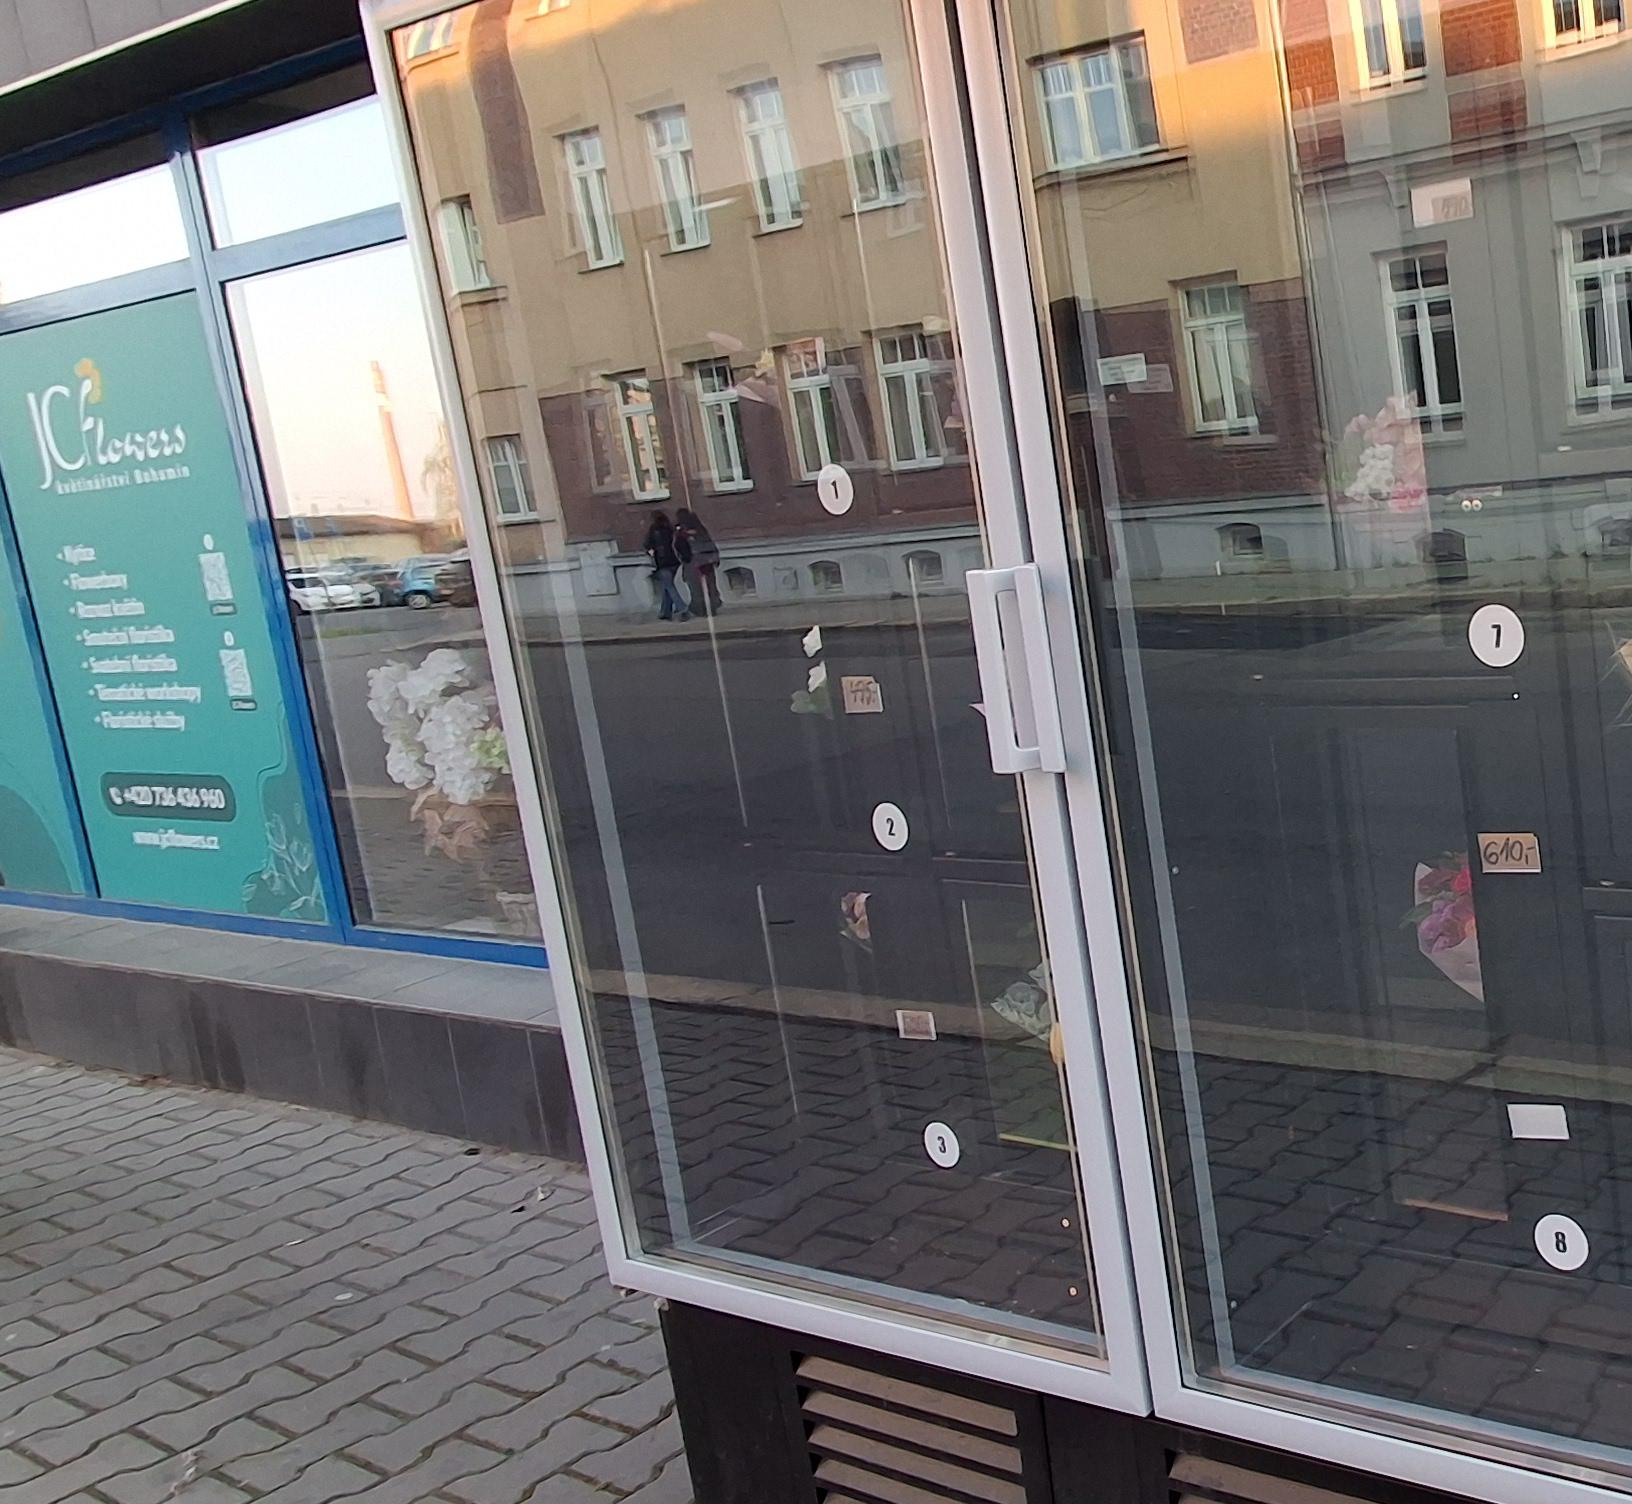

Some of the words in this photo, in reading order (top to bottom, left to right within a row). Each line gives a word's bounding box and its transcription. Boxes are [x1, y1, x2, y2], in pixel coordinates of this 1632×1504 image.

[831, 479, 839, 499] 1
[1491, 623, 1502, 648] 7
[886, 817, 896, 837] 2
[938, 1136, 947, 1154] 3
[1554, 1231, 1568, 1254] 8
